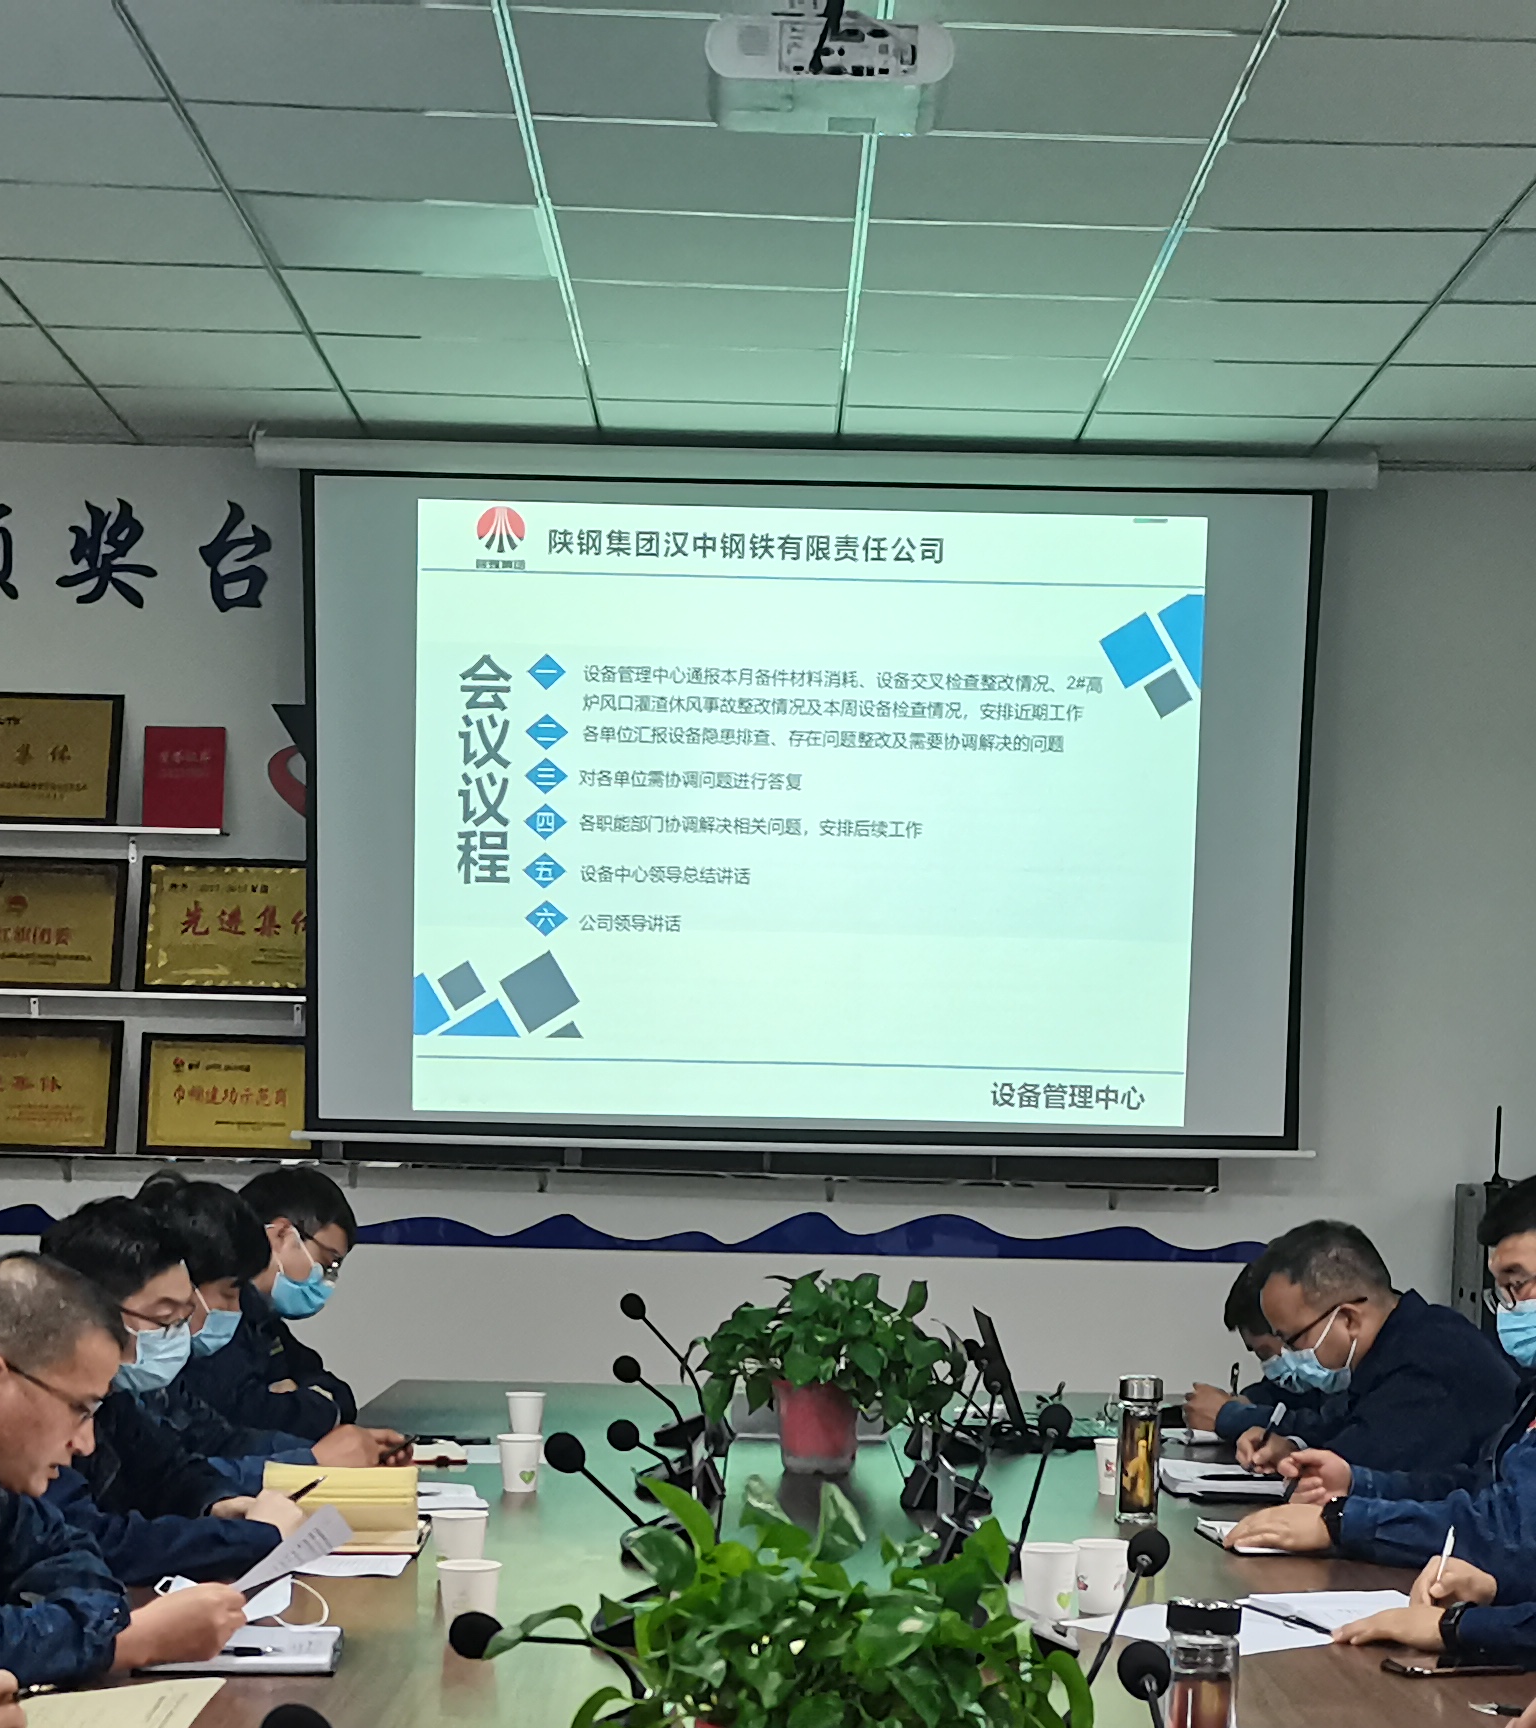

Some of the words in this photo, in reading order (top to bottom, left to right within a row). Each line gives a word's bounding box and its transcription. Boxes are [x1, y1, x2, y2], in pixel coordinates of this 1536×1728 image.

[547, 528, 945, 565] 陕钢集团汉中钢铁有限责任公司
[457, 654, 512, 886] 会议议程
[579, 768, 803, 792] 对各单位需协调问题进行答复
[535, 812, 556, 831] 四
[579, 813, 924, 840] 各职能部门协调解决相关问题，安排后续工作
[534, 860, 556, 880] 五
[579, 864, 752, 886] 设备中心领导总结讲话
[534, 909, 558, 929] 六
[579, 914, 682, 933] 公司领导讲话
[991, 1081, 1146, 1111] 设备管理中心
